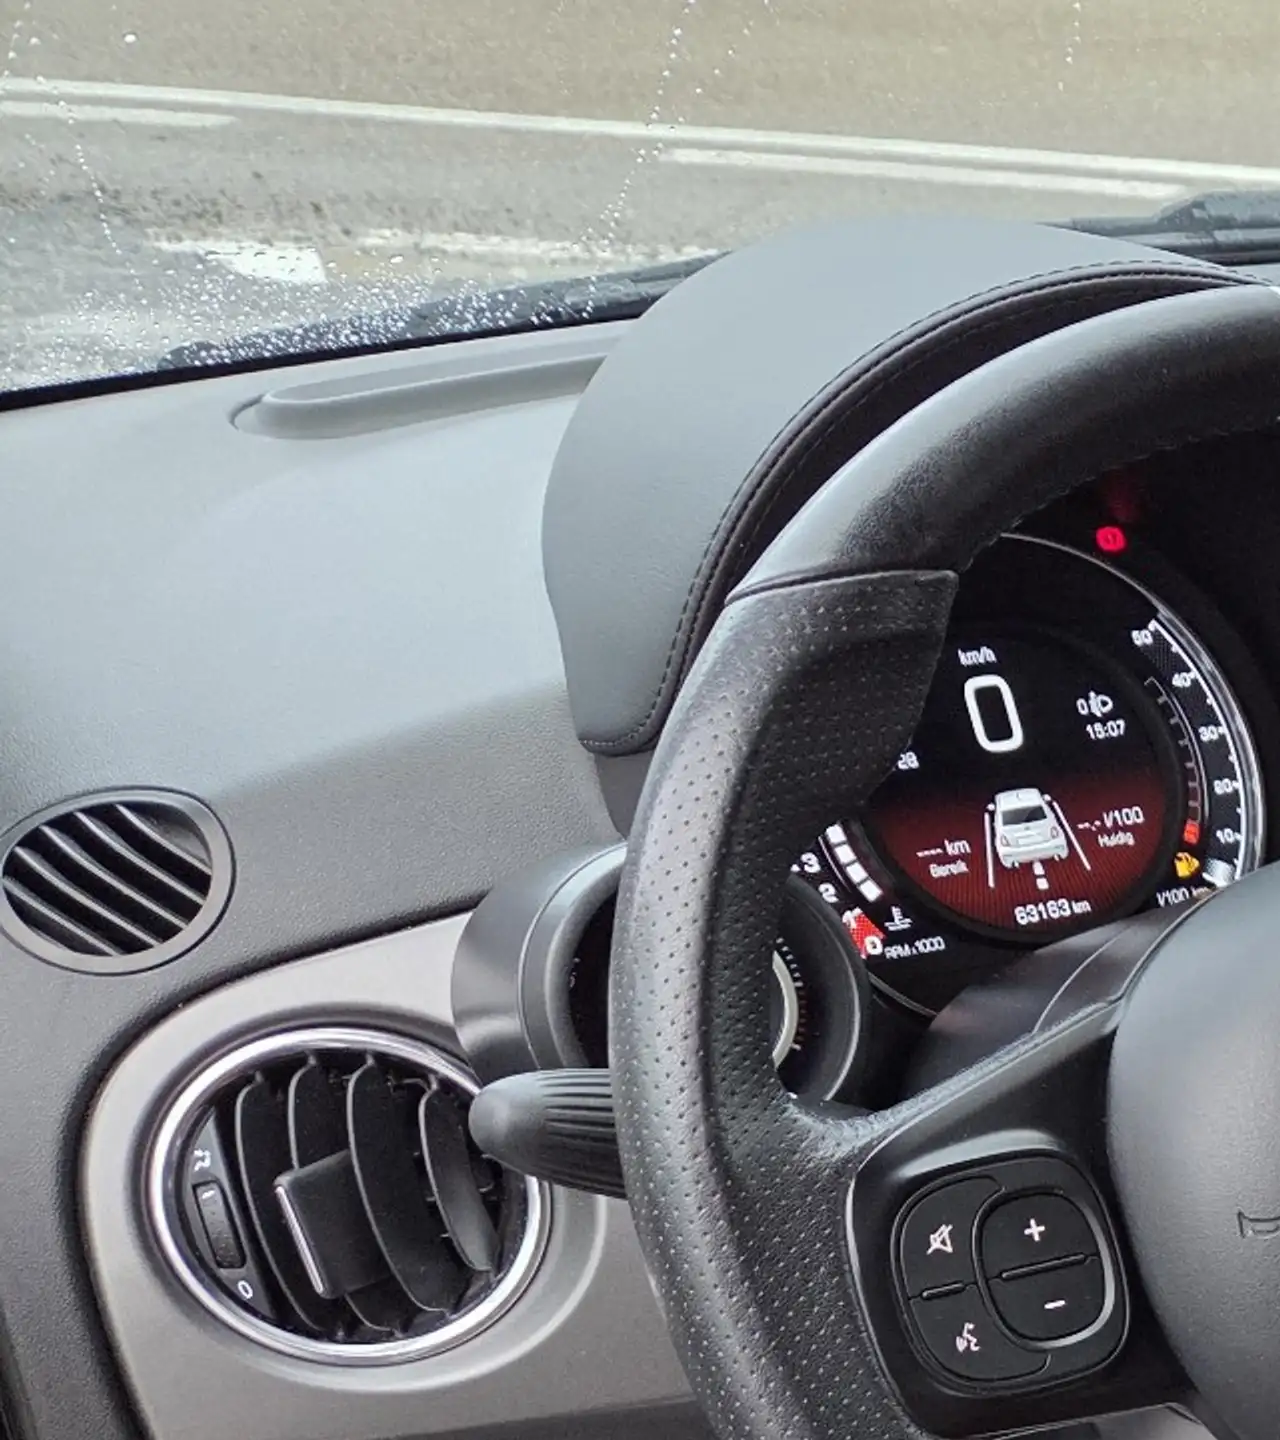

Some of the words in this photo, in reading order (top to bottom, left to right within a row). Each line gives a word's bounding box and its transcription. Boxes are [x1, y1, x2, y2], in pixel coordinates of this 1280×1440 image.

[957, 646, 997, 667] km/h
[964, 674, 1024, 753] 0
[1086, 719, 1126, 740] 15:07
[1216, 828, 1235, 844] 10
[1014, 898, 1071, 925] 63163
